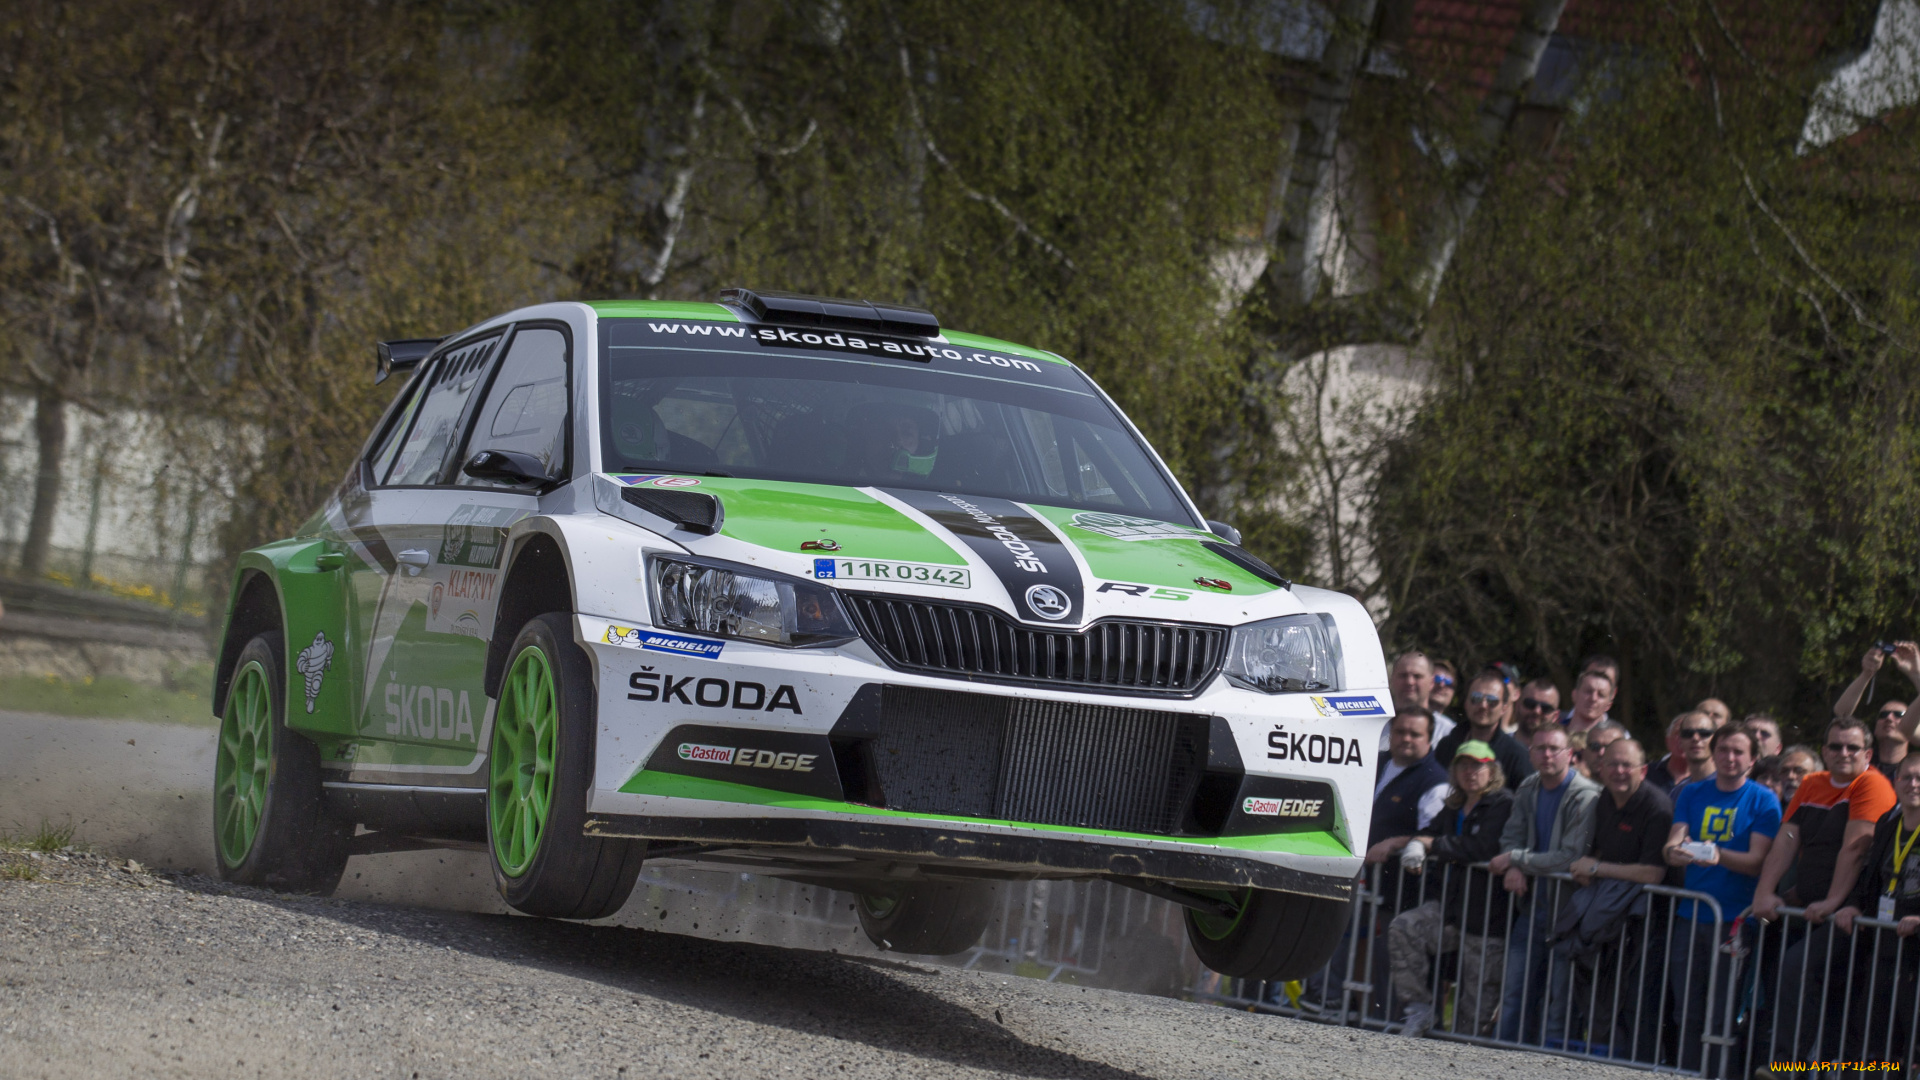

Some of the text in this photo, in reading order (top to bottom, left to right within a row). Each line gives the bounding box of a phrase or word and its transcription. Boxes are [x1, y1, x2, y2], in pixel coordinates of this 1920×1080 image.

[648, 322, 1042, 374] www.skoda-auto.com
[985, 526, 1048, 574] ŠKODA
[447, 570, 497, 600] KLATOVY
[818, 570, 833, 578] CZ
[841, 562, 965, 586] 11R 0342
[1096, 582, 1193, 601] R5
[646, 636, 723, 653] MICHELIN
[627, 665, 802, 715] ŠKODA
[385, 671, 475, 743] ŠKODA
[1335, 700, 1380, 709] MICHELIN
[1267, 724, 1363, 767] ŠKODA
[691, 746, 819, 772] Castrol EDGE
[1252, 799, 1324, 817] Castrol EDGE
